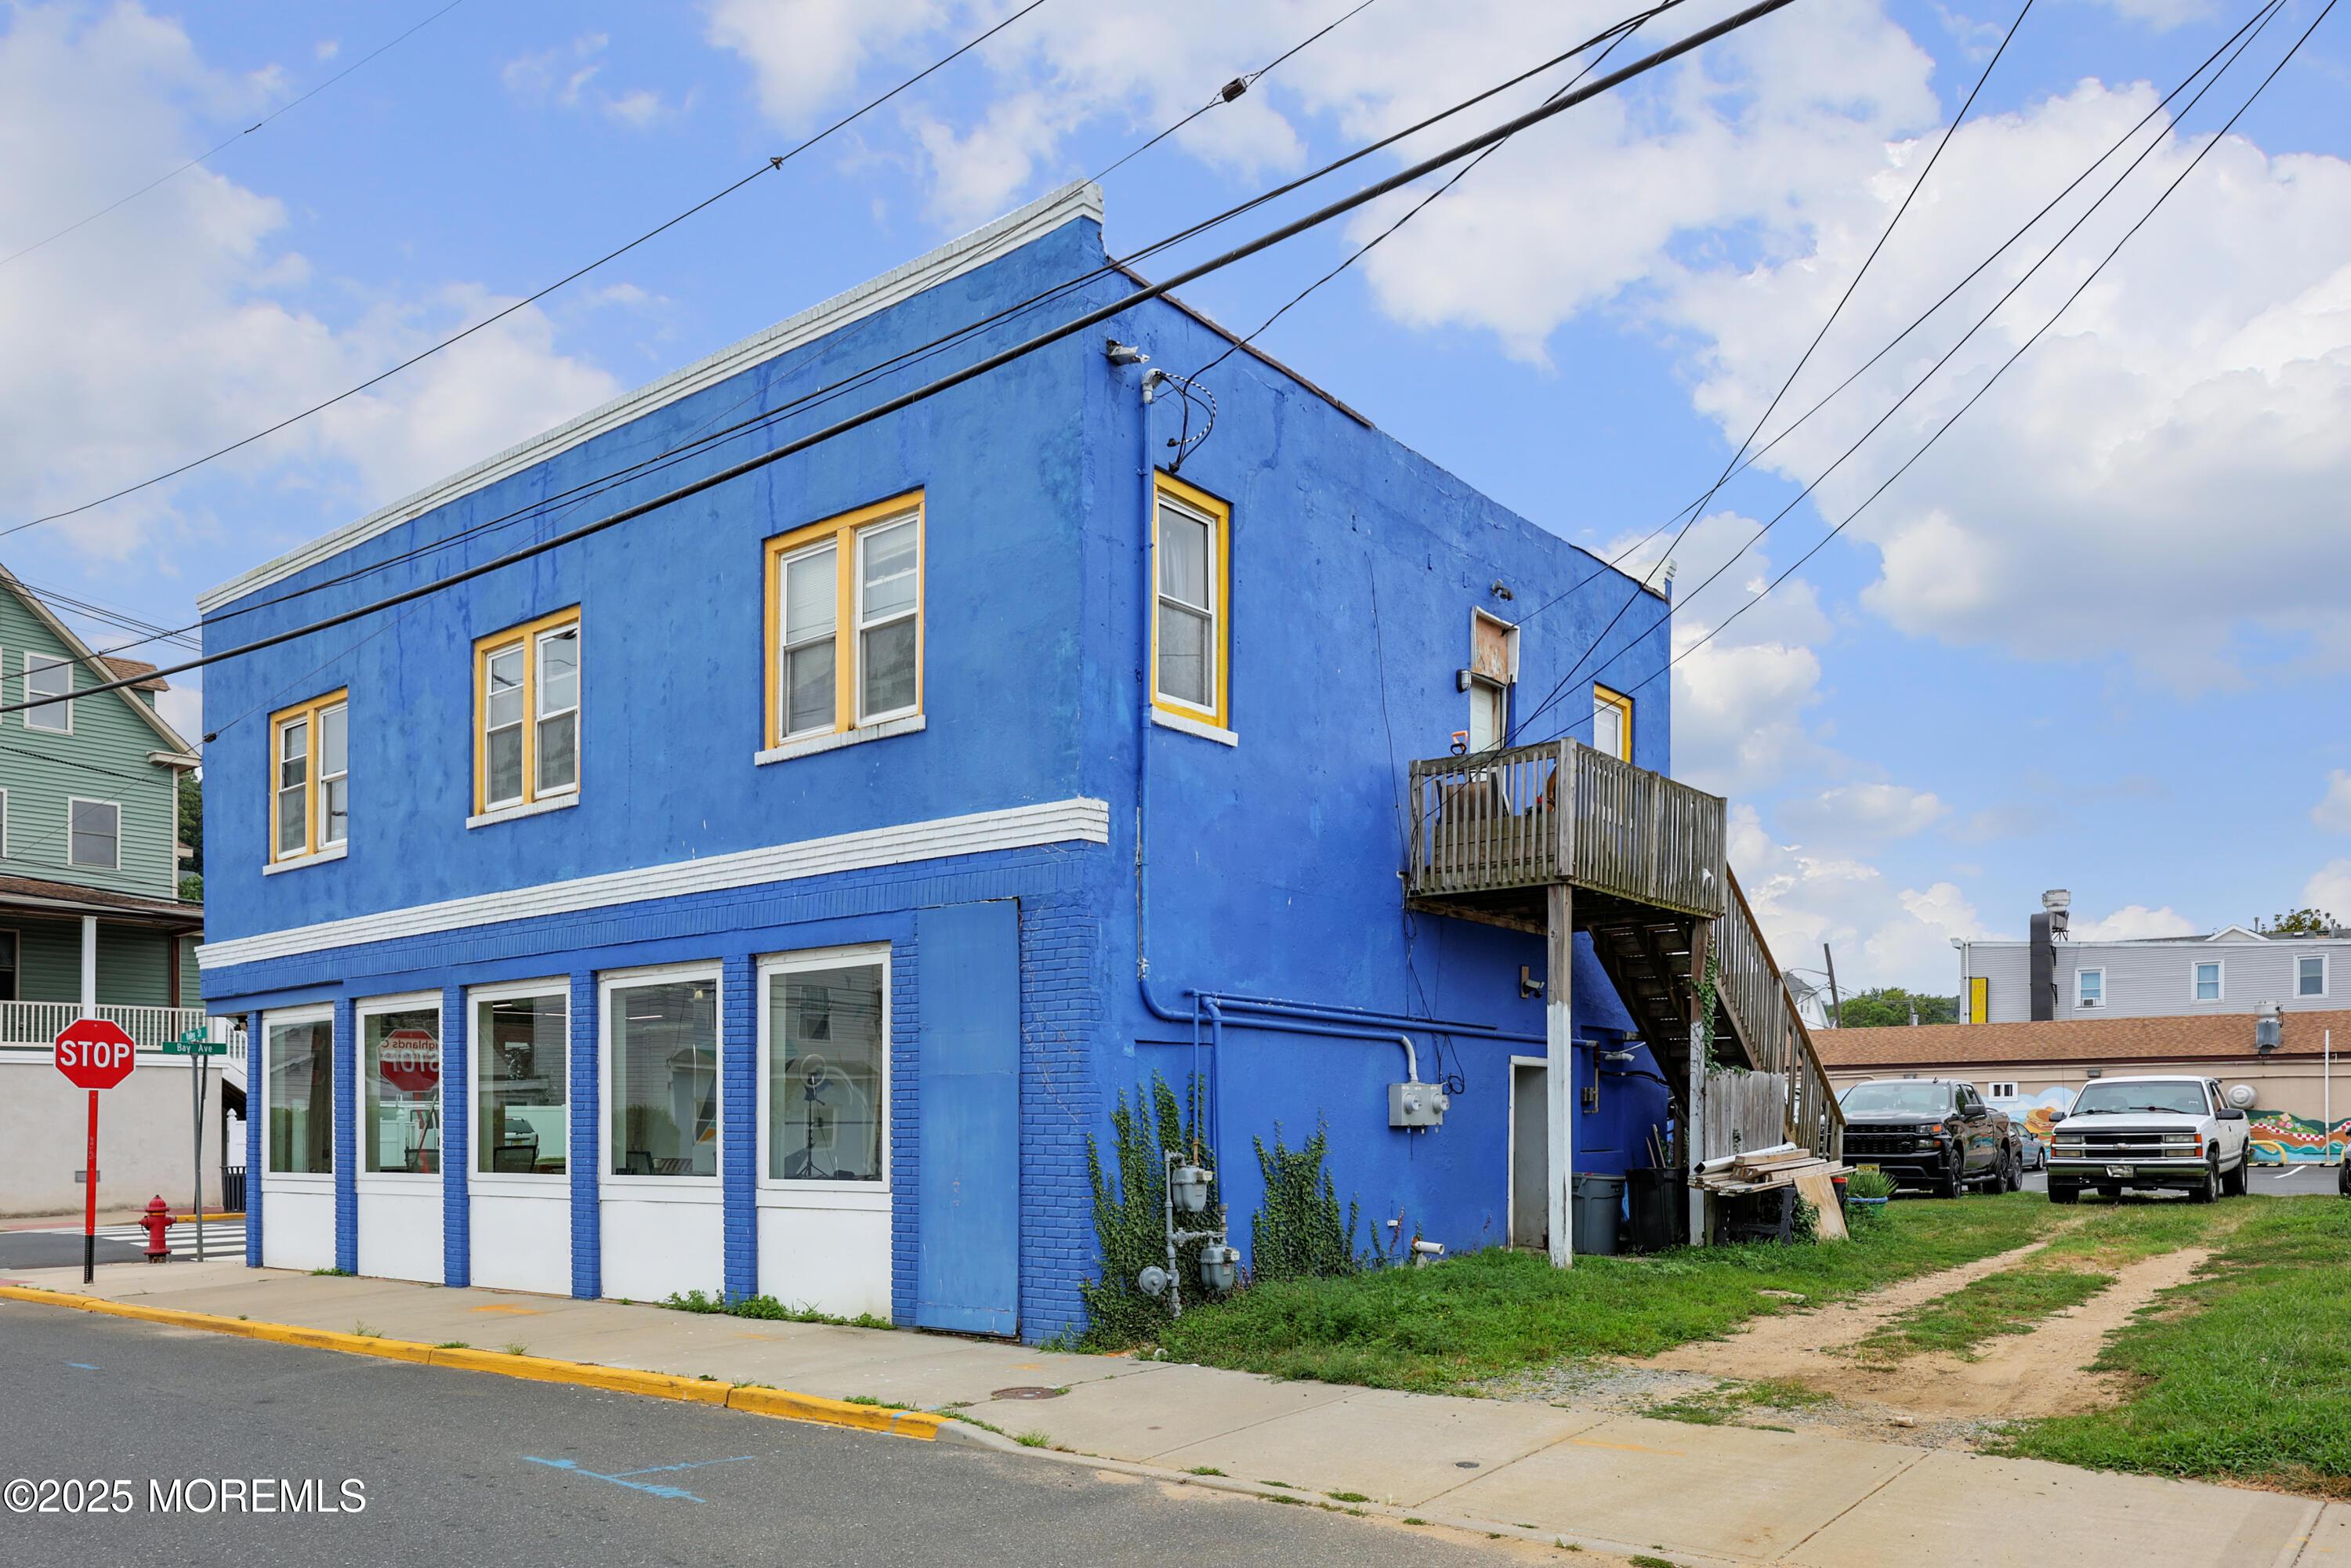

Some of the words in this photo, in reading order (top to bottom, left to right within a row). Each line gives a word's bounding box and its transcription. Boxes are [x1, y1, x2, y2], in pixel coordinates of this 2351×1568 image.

[60, 1040, 130, 1068] STOP
[177, 1043, 191, 1053] Bay
[198, 1044, 213, 1052] Ave
